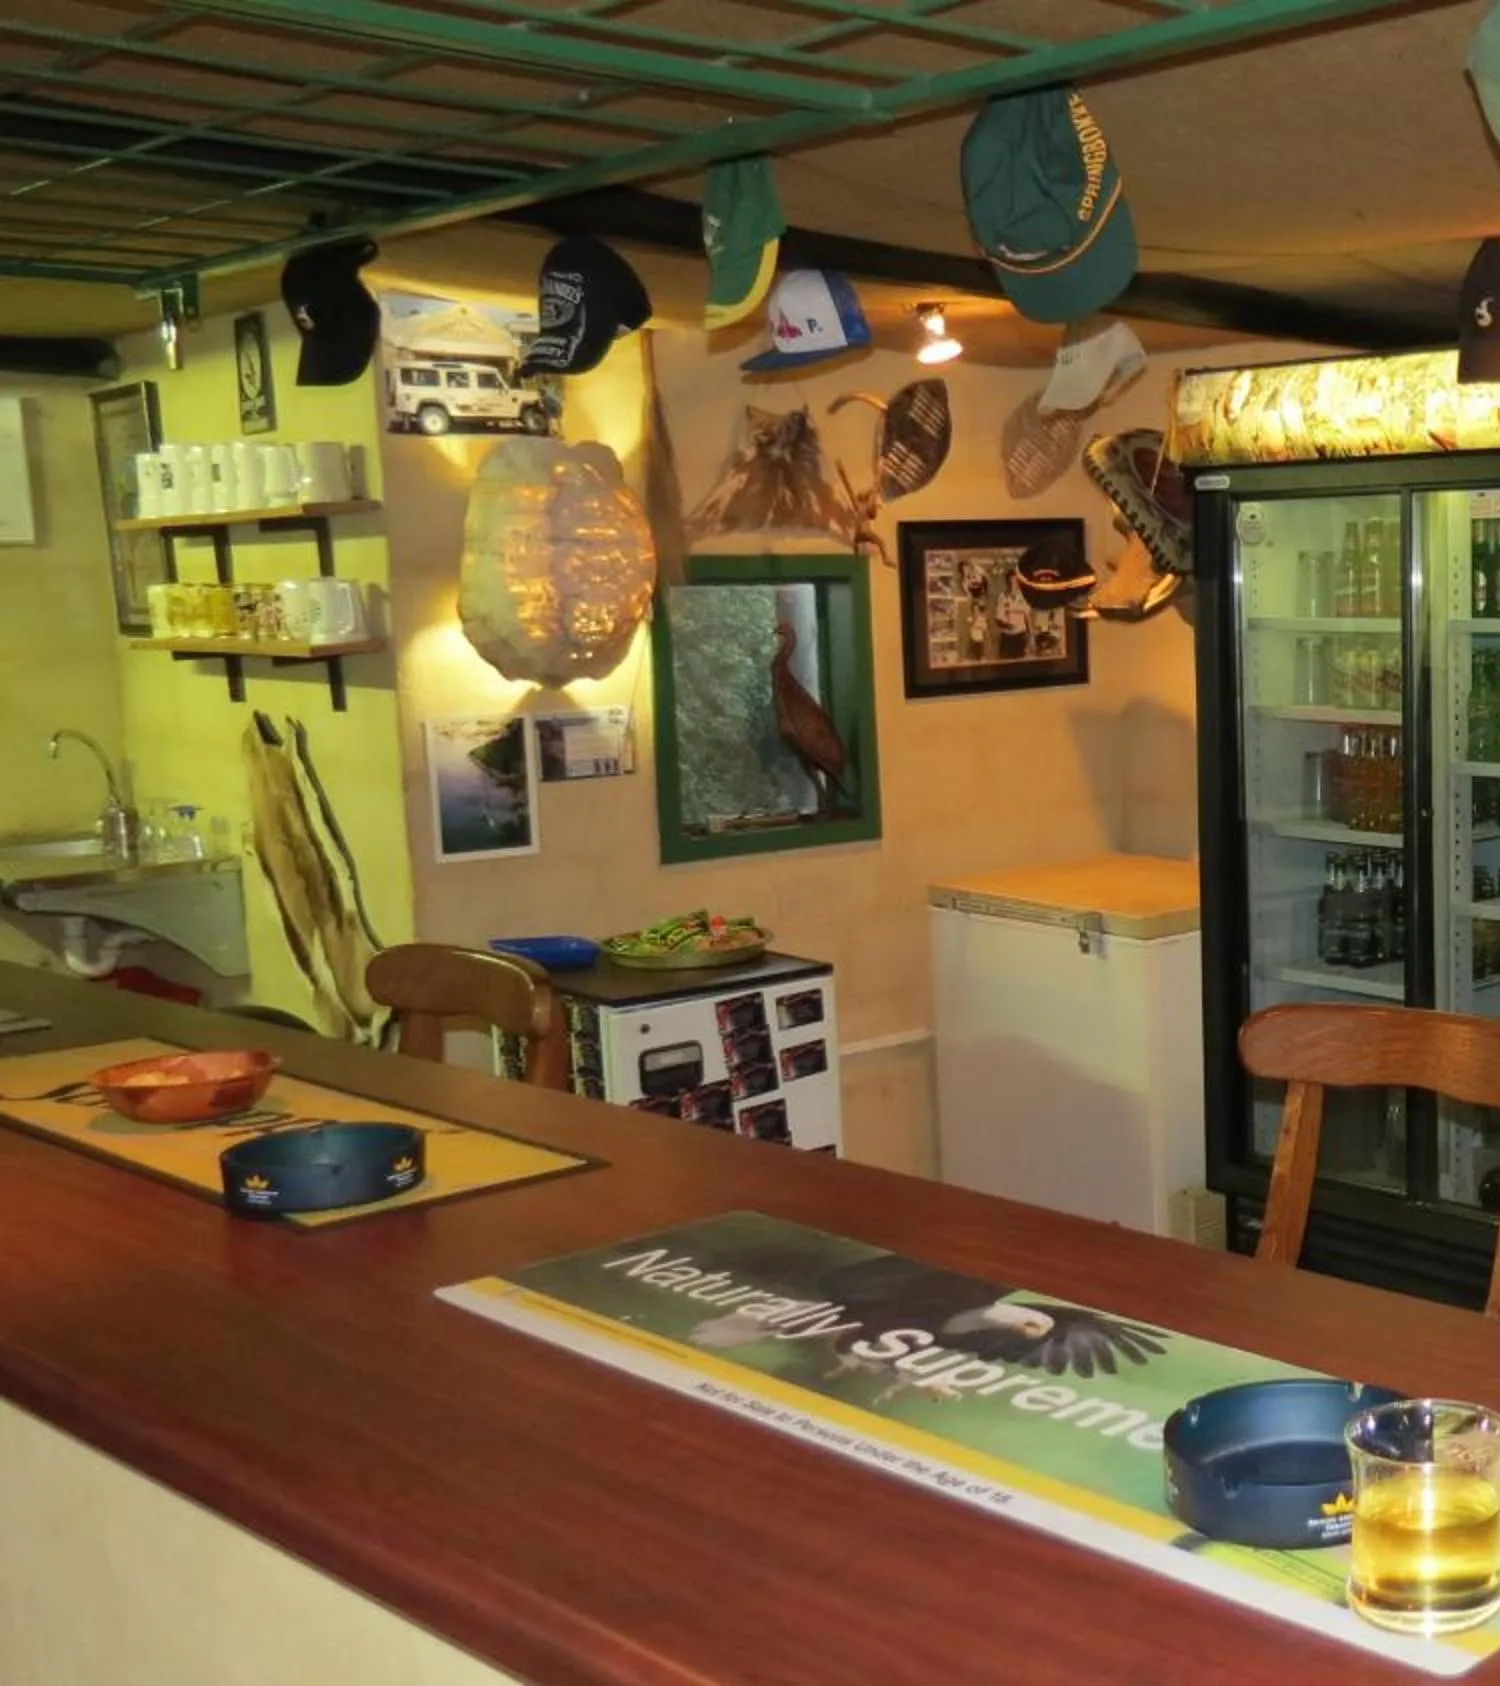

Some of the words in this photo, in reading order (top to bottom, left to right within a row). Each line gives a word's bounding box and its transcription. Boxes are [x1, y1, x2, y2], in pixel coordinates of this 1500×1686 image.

[603, 1248, 864, 1339] Naturally
[851, 1327, 1166, 1451] Supreme
[793, 1416, 853, 1447] Persons
[854, 1440, 902, 1463] Under
[934, 1470, 967, 1490] Age
